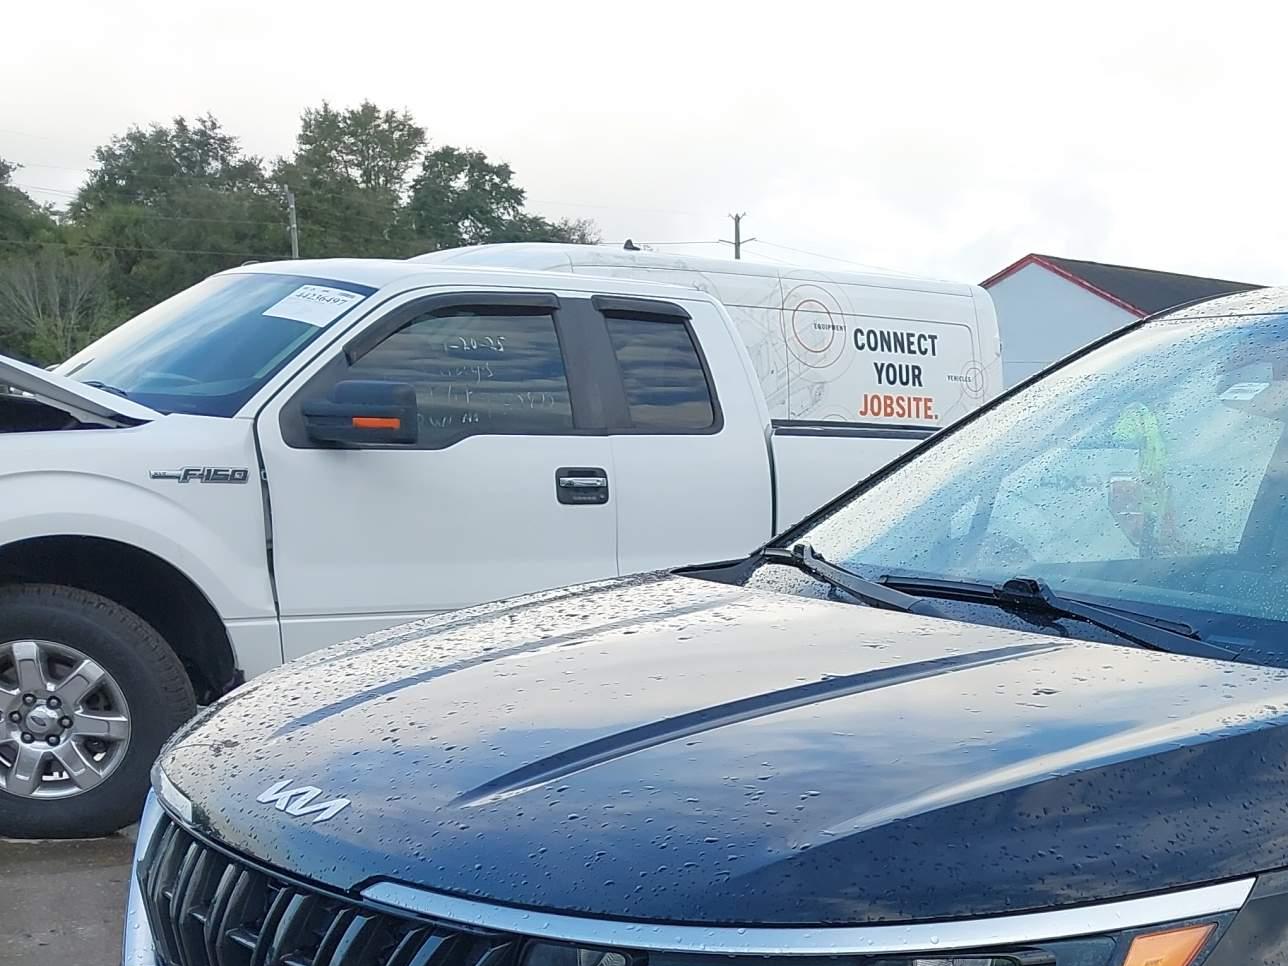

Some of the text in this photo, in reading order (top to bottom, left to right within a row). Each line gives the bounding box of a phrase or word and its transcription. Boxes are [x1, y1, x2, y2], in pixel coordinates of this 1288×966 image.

[295, 292, 348, 306] 44236497
[813, 322, 847, 332] EQUIPMENT
[853, 328, 938, 356] CONNECT
[873, 362, 923, 387] YOUR
[947, 375, 972, 383] VEHICLES
[859, 393, 939, 420] JOBSITE.
[178, 466, 249, 484] F-150
[256, 778, 352, 825] KIA
